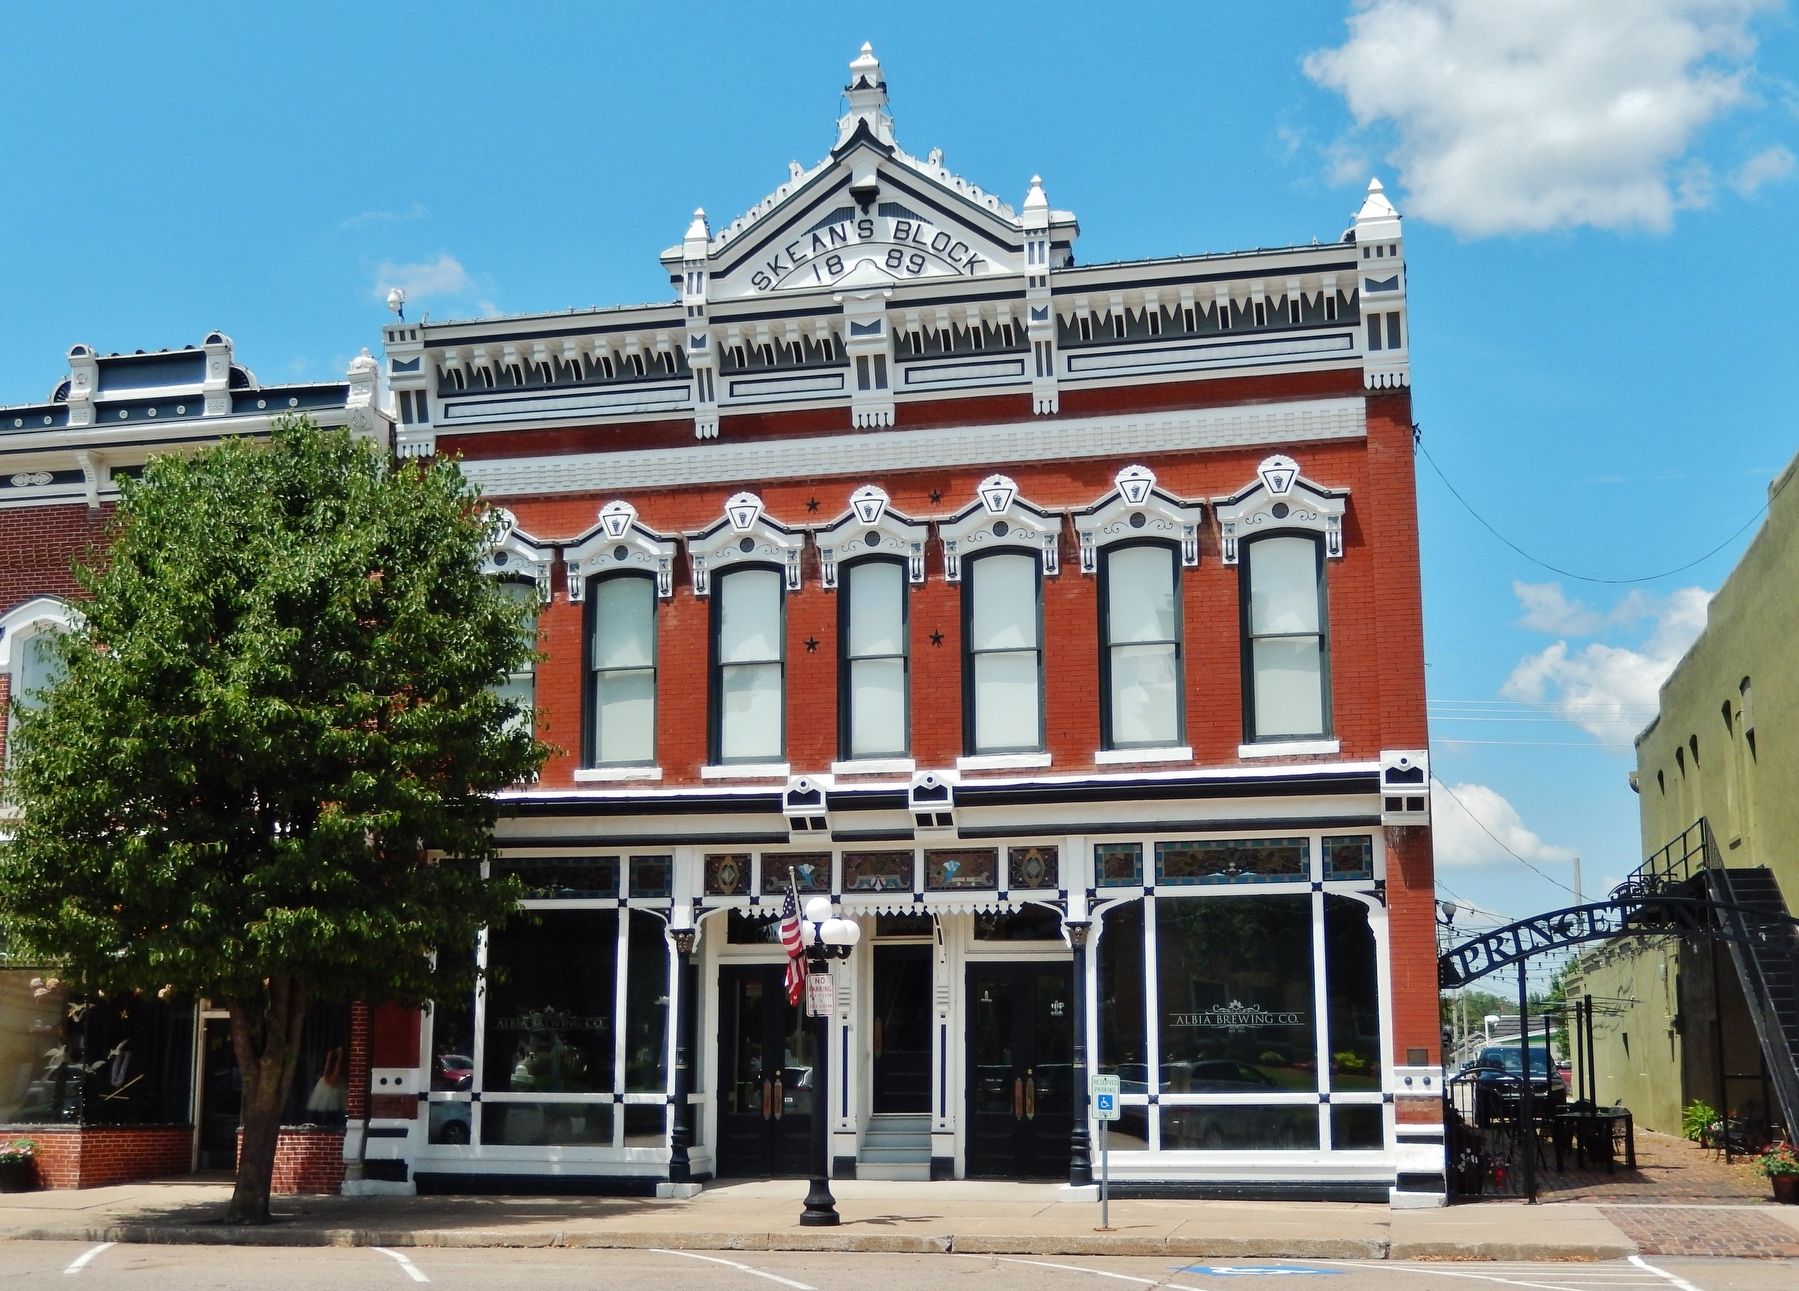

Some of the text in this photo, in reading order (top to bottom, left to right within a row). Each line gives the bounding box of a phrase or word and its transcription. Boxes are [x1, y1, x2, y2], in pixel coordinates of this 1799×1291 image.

[751, 219, 986, 290] SKEAN'S BLOCK
[1176, 1014, 1299, 1025] ALBIA BREWING CO.
